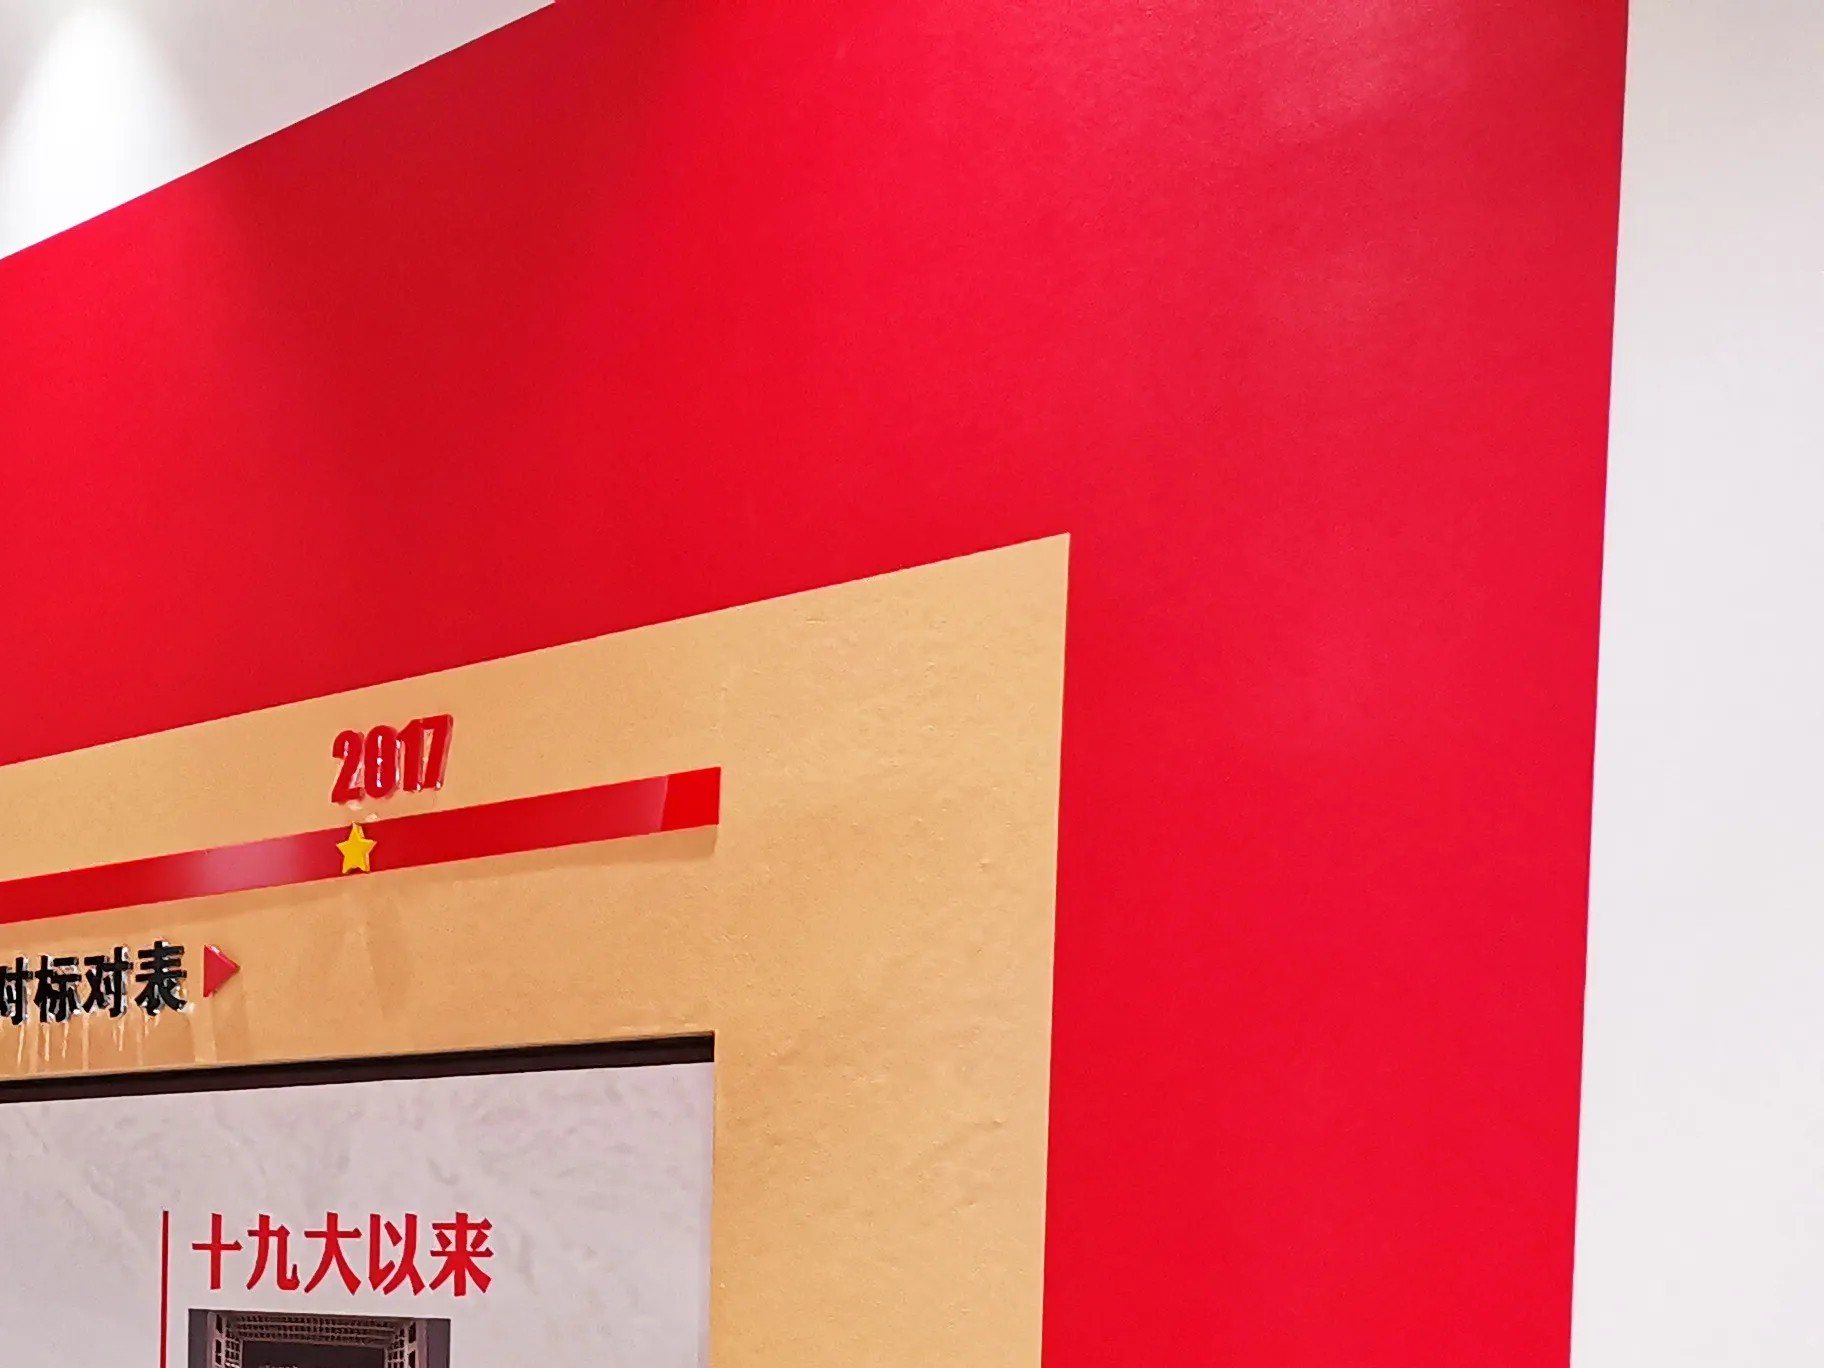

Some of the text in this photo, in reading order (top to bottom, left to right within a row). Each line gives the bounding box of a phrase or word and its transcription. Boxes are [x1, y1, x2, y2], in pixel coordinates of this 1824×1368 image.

[331, 714, 454, 803] 2017
[191, 1211, 494, 1297] 十九大以来
